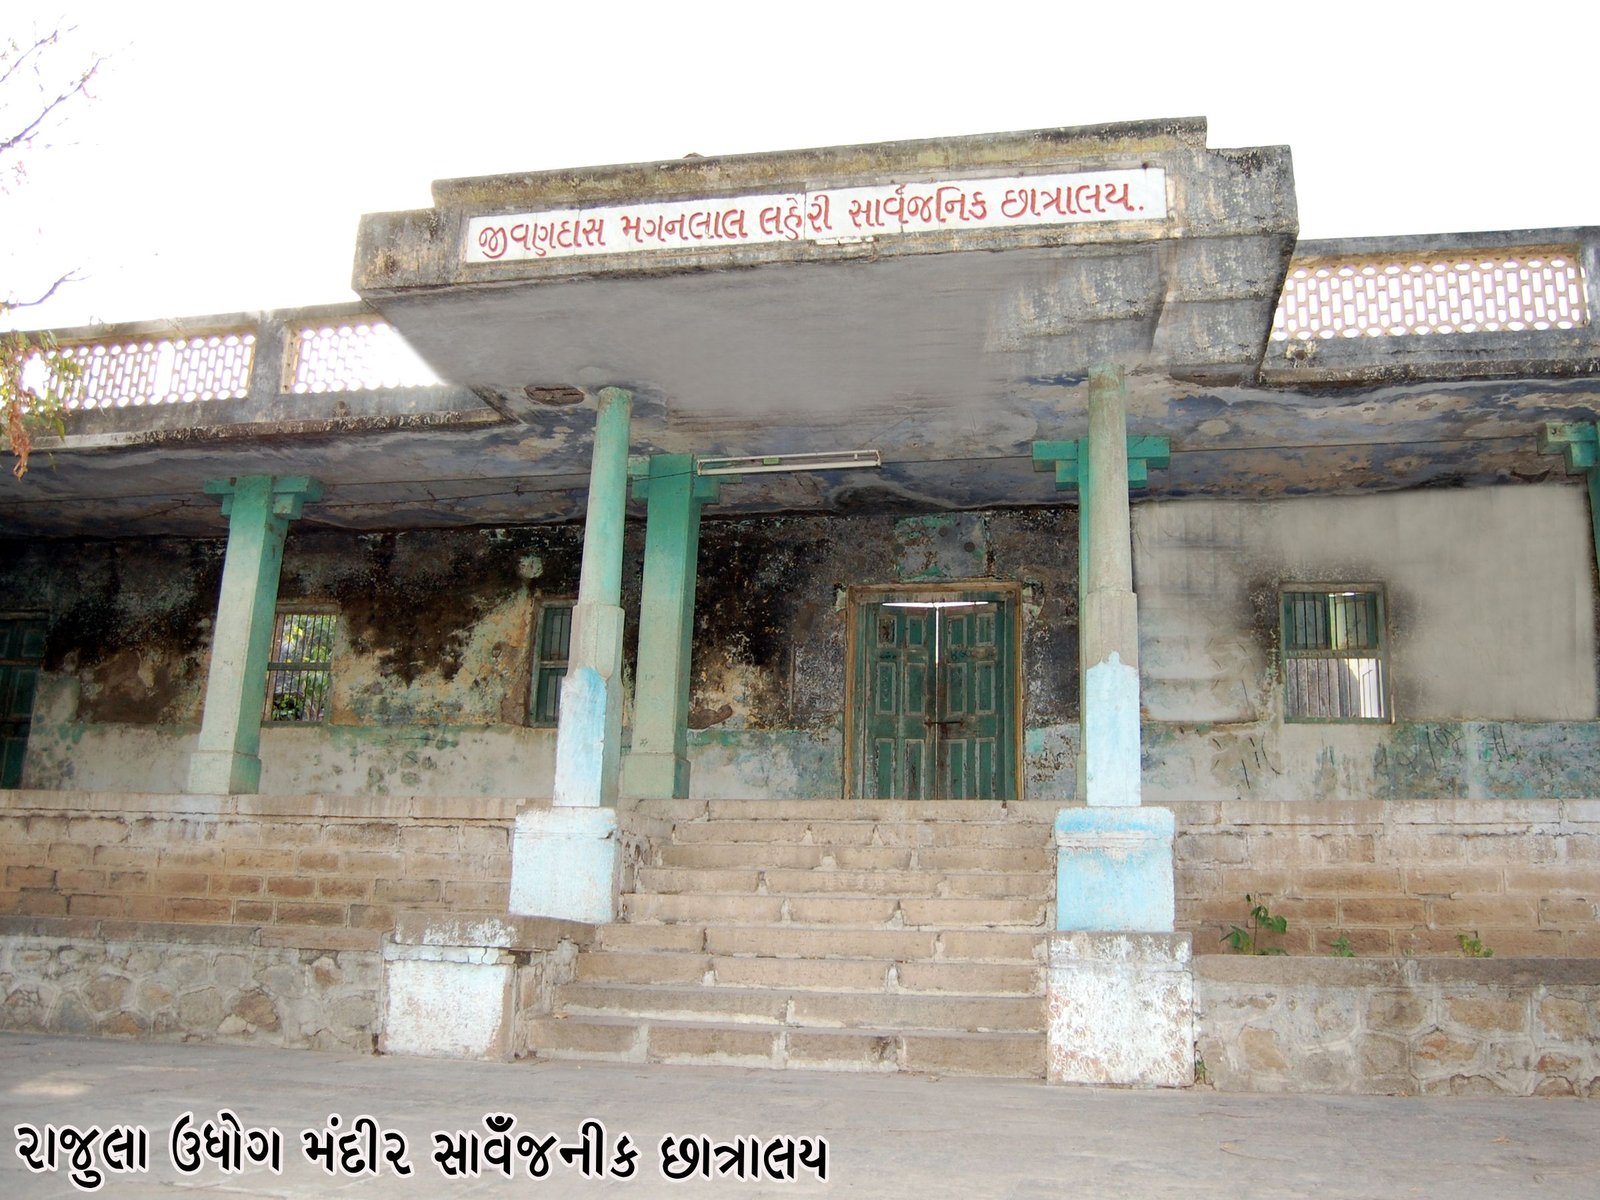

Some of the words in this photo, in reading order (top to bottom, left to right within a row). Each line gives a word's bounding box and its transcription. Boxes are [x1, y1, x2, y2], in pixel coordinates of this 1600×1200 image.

[478, 218, 606, 260] જીવણદાસ
[620, 208, 748, 242] મગનલાલ
[759, 194, 833, 241] લહેરી
[848, 184, 988, 229] સાર્વજનિક
[1000, 183, 1144, 218] છાત્રાલય.
